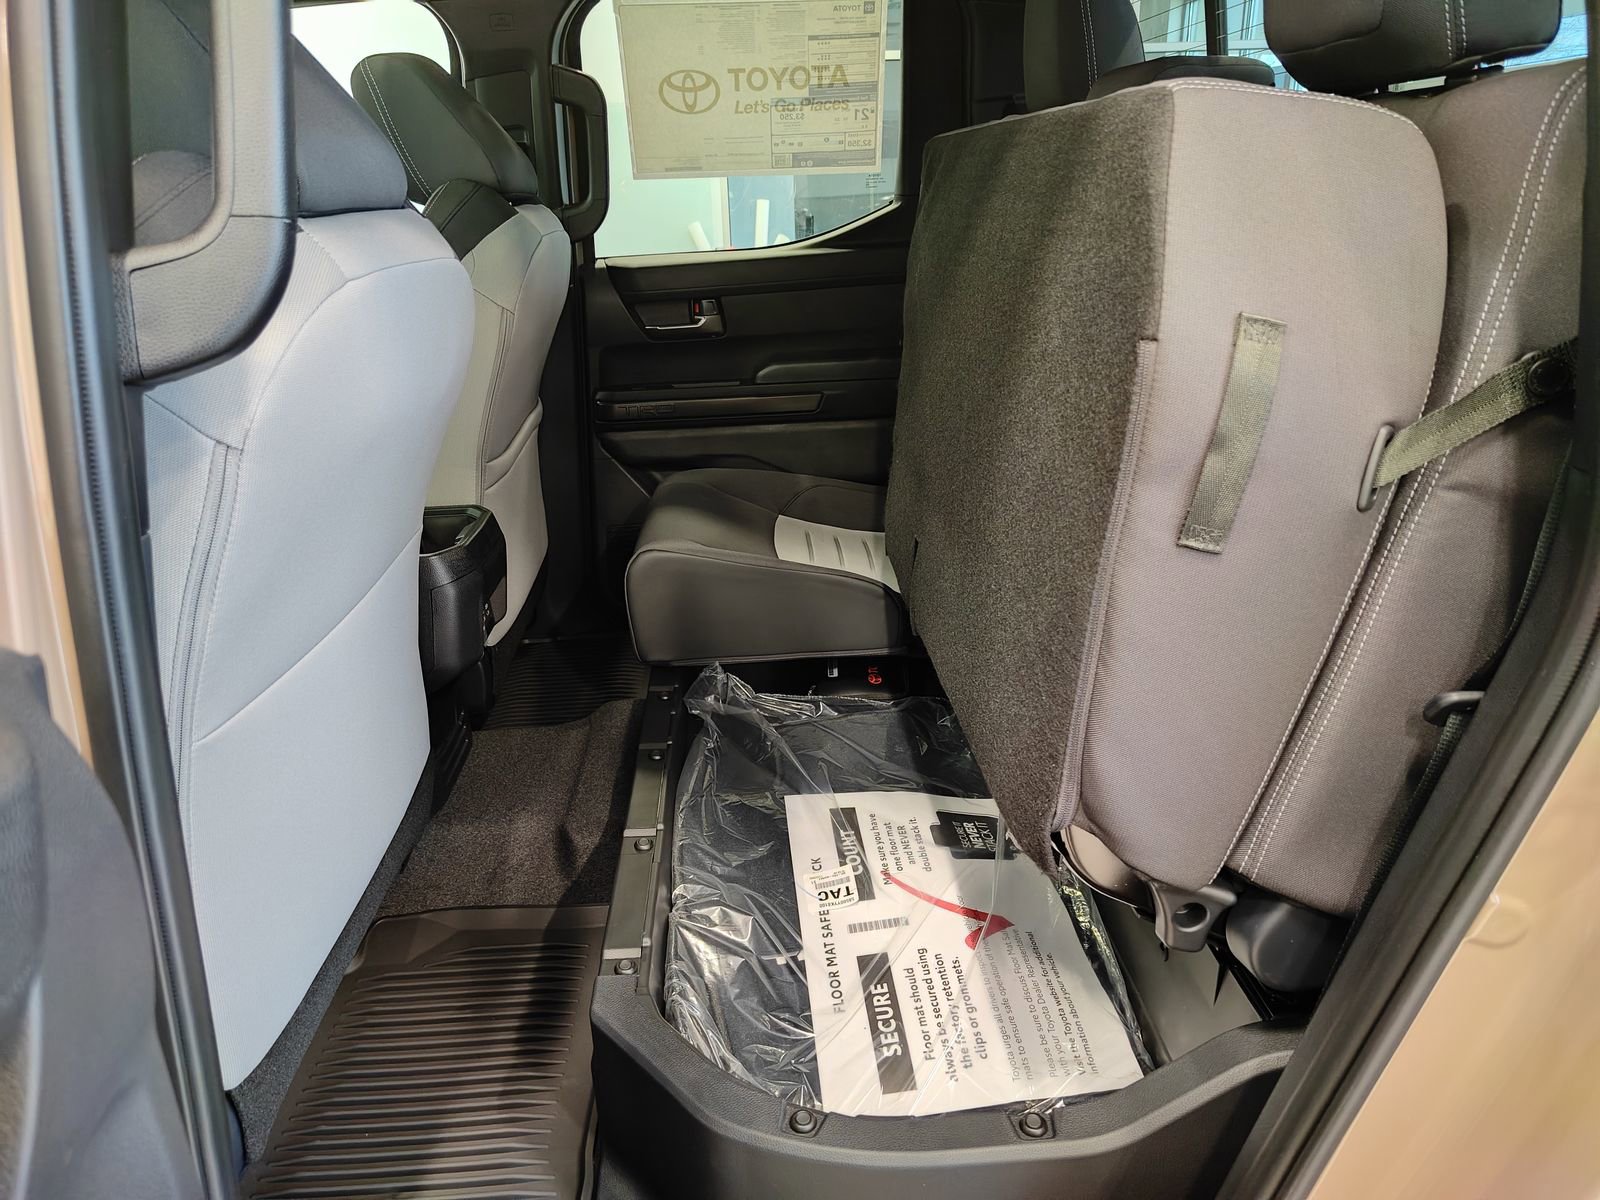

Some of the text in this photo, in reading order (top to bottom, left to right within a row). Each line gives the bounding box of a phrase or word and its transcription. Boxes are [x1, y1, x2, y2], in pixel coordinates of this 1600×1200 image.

[727, 64, 849, 92] TOYOTA
[734, 96, 849, 114] Let's Go Places
[883, 822, 903, 871] one floor mat
[897, 825, 916, 864] and NEVER
[911, 825, 923, 844] stack
[955, 827, 971, 848] SECURE
[964, 822, 986, 849] NEVER
[981, 829, 997, 851] STACK
[841, 829, 863, 876] COUNT
[869, 813, 892, 885] Make sure you have
[918, 846, 932, 872] double
[817, 886, 854, 901] TAC
[811, 857, 845, 1013] FLOOR MAT SAFE CK
[917, 948, 931, 975] using
[985, 953, 994, 961] of
[1005, 942, 1015, 955] Mat
[934, 953, 954, 1001] retention
[1011, 957, 1022, 974] Floor
[984, 977, 991, 985] to
[990, 962, 1007, 996] operation
[1018, 975, 1033, 1003] discuss
[922, 978, 942, 1019] secured
[987, 986, 1000, 1012] drivers
[1002, 998, 1013, 1014] safe
[1013, 929, 1071, 1077] with your Toyota Dealer Representative
[1025, 931, 1086, 1076] Visit the Toyota website for additional
[1029, 1004, 1037, 1013] to
[870, 983, 902, 1057] SECURE
[903, 968, 935, 1060] Floor mat should
[969, 1017, 978, 1028] or
[993, 1013, 1003, 1023] all
[1032, 1015, 1043, 1032] sure
[1046, 952, 1099, 1074] information about your vehicle.
[936, 1022, 947, 1036] be
[999, 1026, 1012, 1049] urges
[1008, 1016, 1022, 1044] ensure
[1039, 1034, 1048, 1045] be
[973, 1031, 988, 1059] clips
[1018, 1045, 1026, 1055] to
[960, 1048, 973, 1069] the
[1007, 1051, 1021, 1081] Toyota
[1021, 1057, 1033, 1080] mats
[1044, 1048, 1058, 1077] Please
